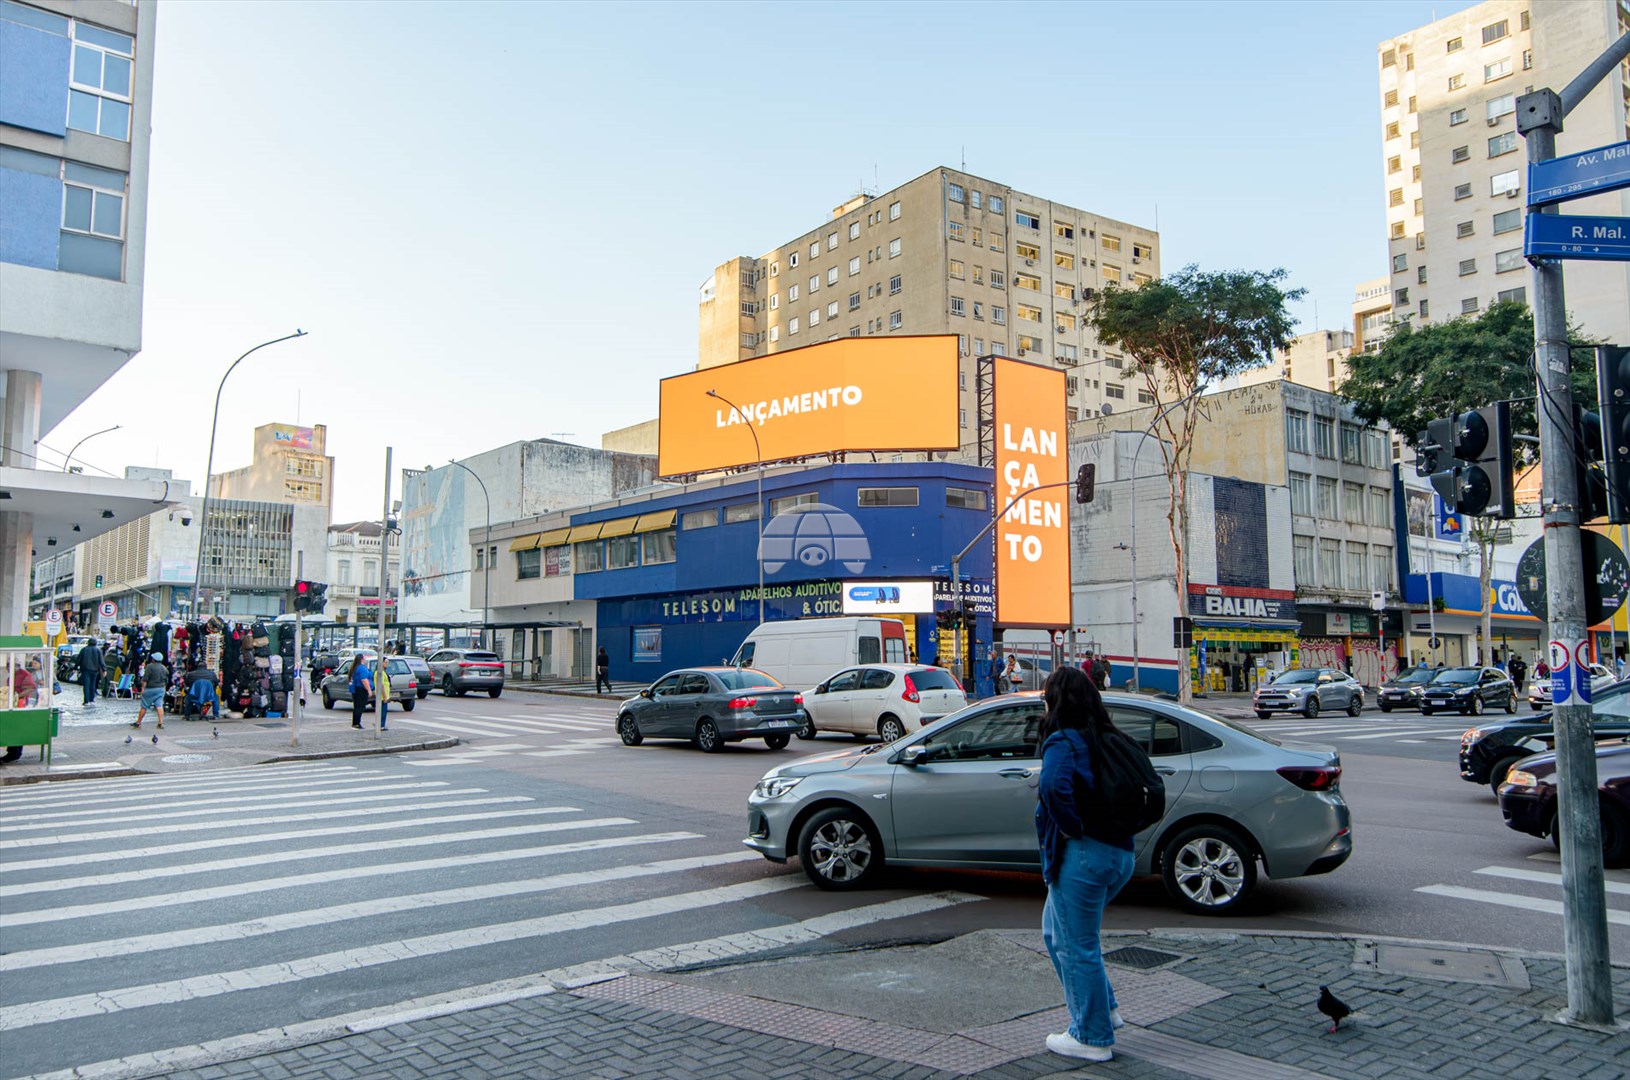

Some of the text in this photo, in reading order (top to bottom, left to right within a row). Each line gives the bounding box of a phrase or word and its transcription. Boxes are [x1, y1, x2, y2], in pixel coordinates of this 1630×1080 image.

[1576, 146, 1630, 168] Av. Mal
[1571, 226, 1626, 239] R. Mal.
[716, 385, 862, 428] LANÇAMENTO
[1003, 423, 1057, 457] LAN
[1004, 460, 1040, 495] ÇA
[1005, 496, 1061, 528] MEN
[1005, 533, 1042, 562] TO
[739, 586, 793, 601] APARELHOS
[935, 581, 990, 593] TELESOM
[105, 604, 112, 614] E
[662, 599, 736, 616] TELESOM
[802, 603, 811, 614] &
[974, 603, 992, 612] ÓTICA
[1206, 596, 1268, 617] BAHIA
[51, 611, 58, 620] E
